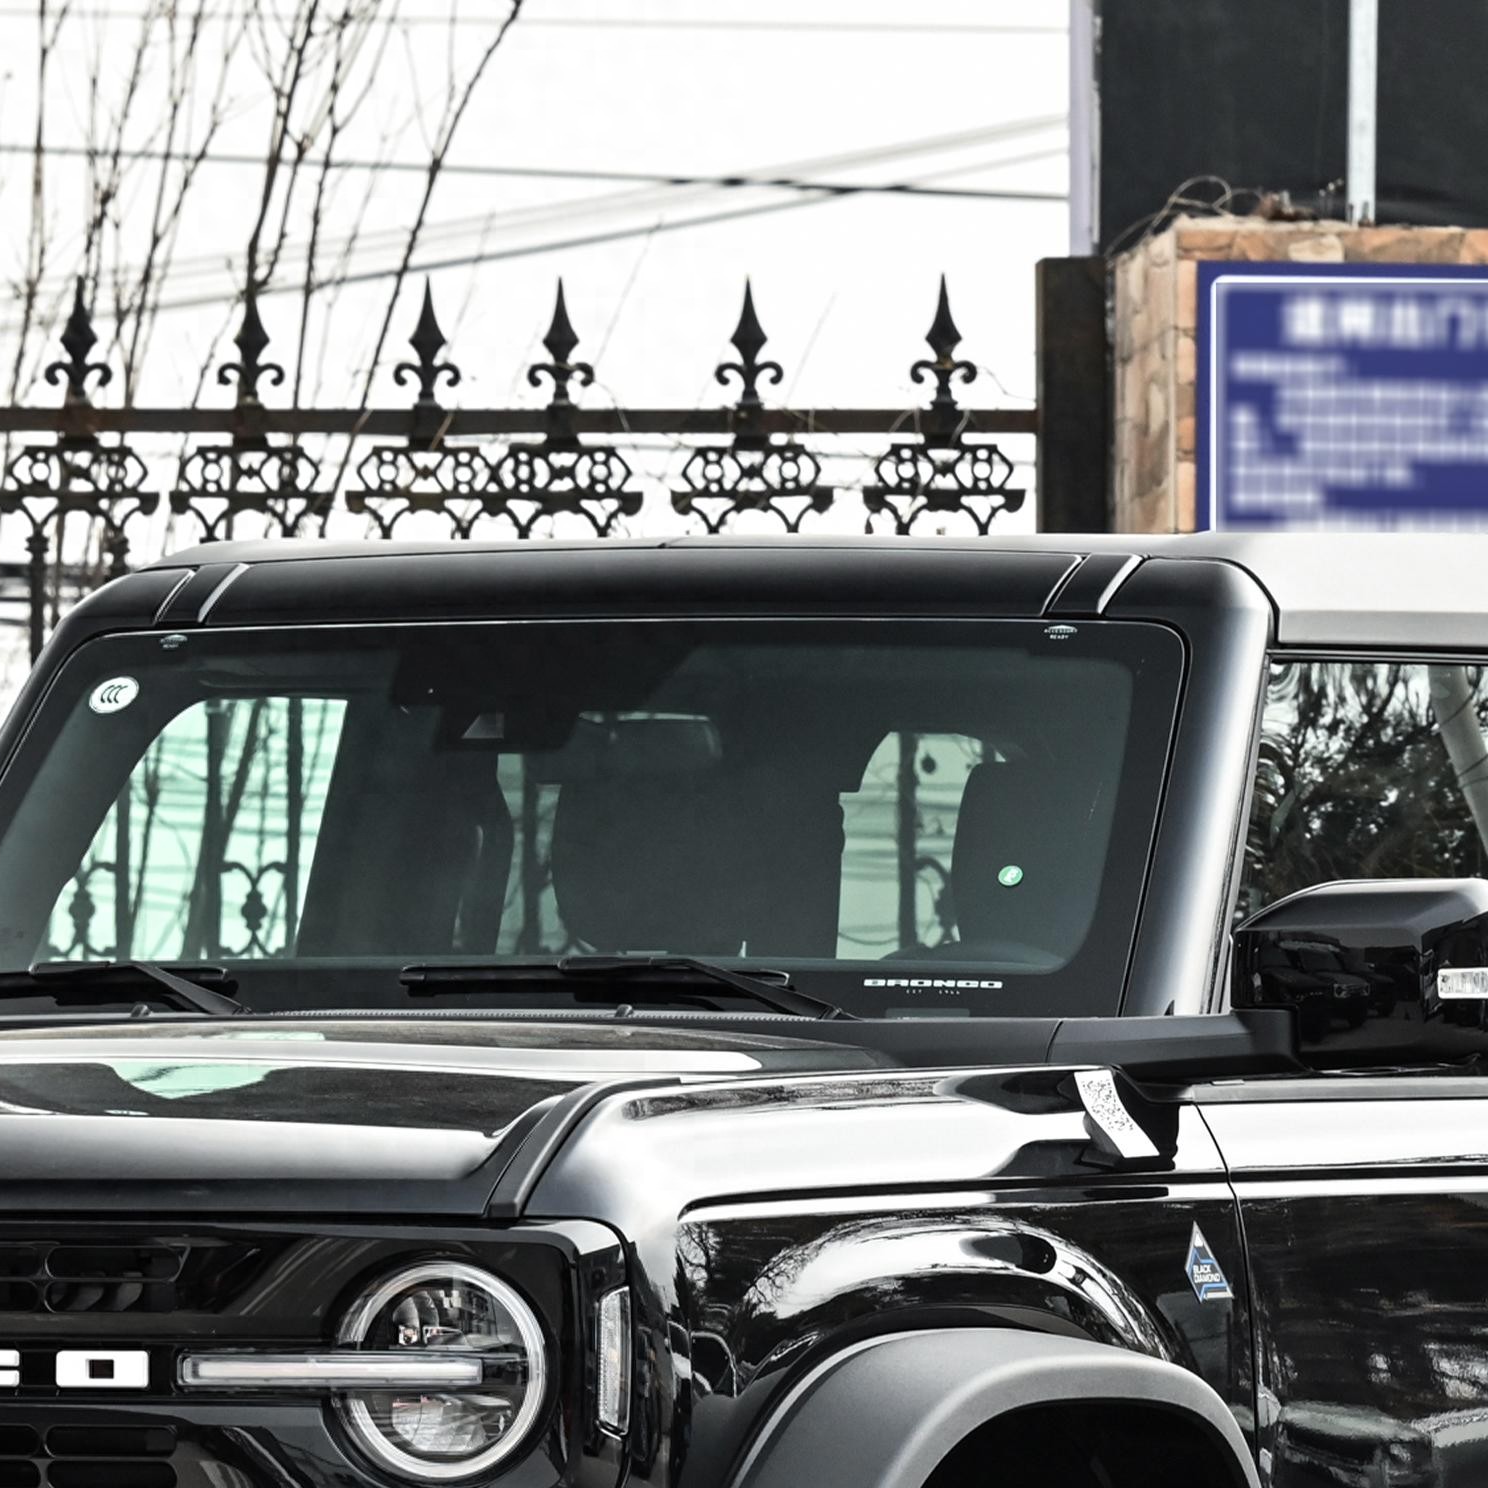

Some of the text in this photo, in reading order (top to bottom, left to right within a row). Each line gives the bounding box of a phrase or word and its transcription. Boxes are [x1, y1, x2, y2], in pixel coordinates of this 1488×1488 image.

[863, 978, 1003, 989] BRONCO
[1193, 1264, 1212, 1274] BLACK
[1194, 1273, 1221, 1284] DIAMOND
